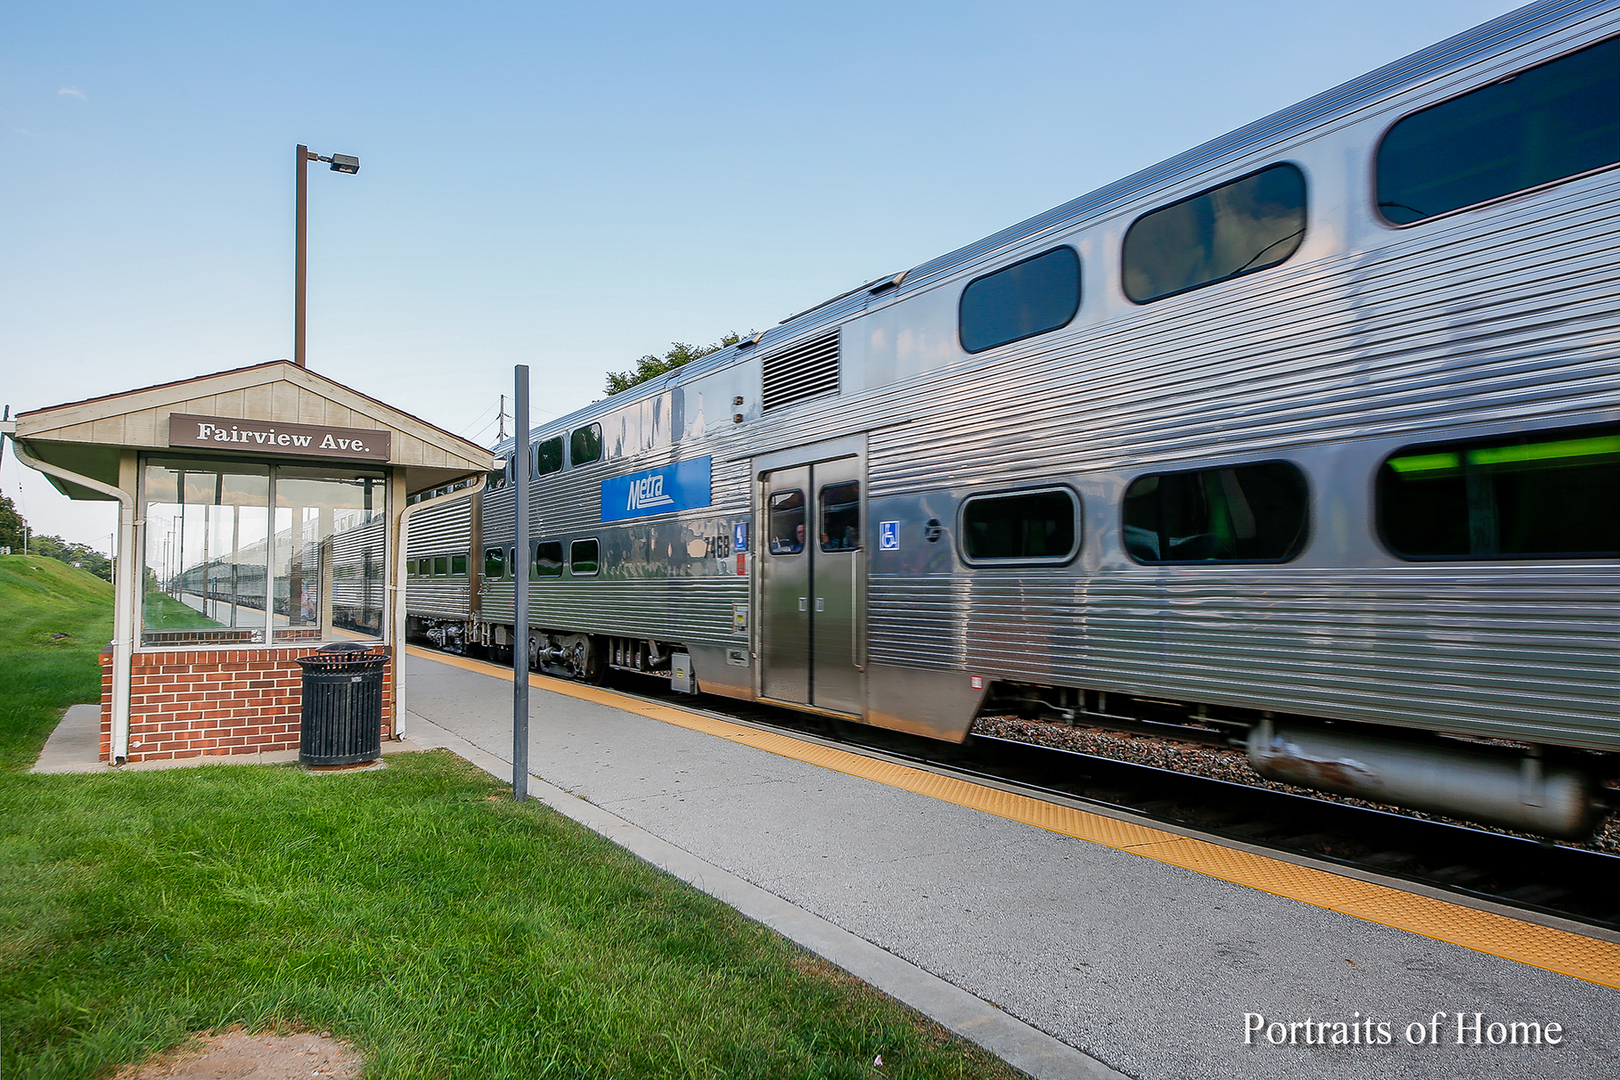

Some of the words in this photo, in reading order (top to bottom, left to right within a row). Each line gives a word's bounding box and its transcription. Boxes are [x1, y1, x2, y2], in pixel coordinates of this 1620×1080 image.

[197, 422, 313, 448] Fairview
[319, 433, 371, 453] Ave.
[627, 474, 673, 511] Metra
